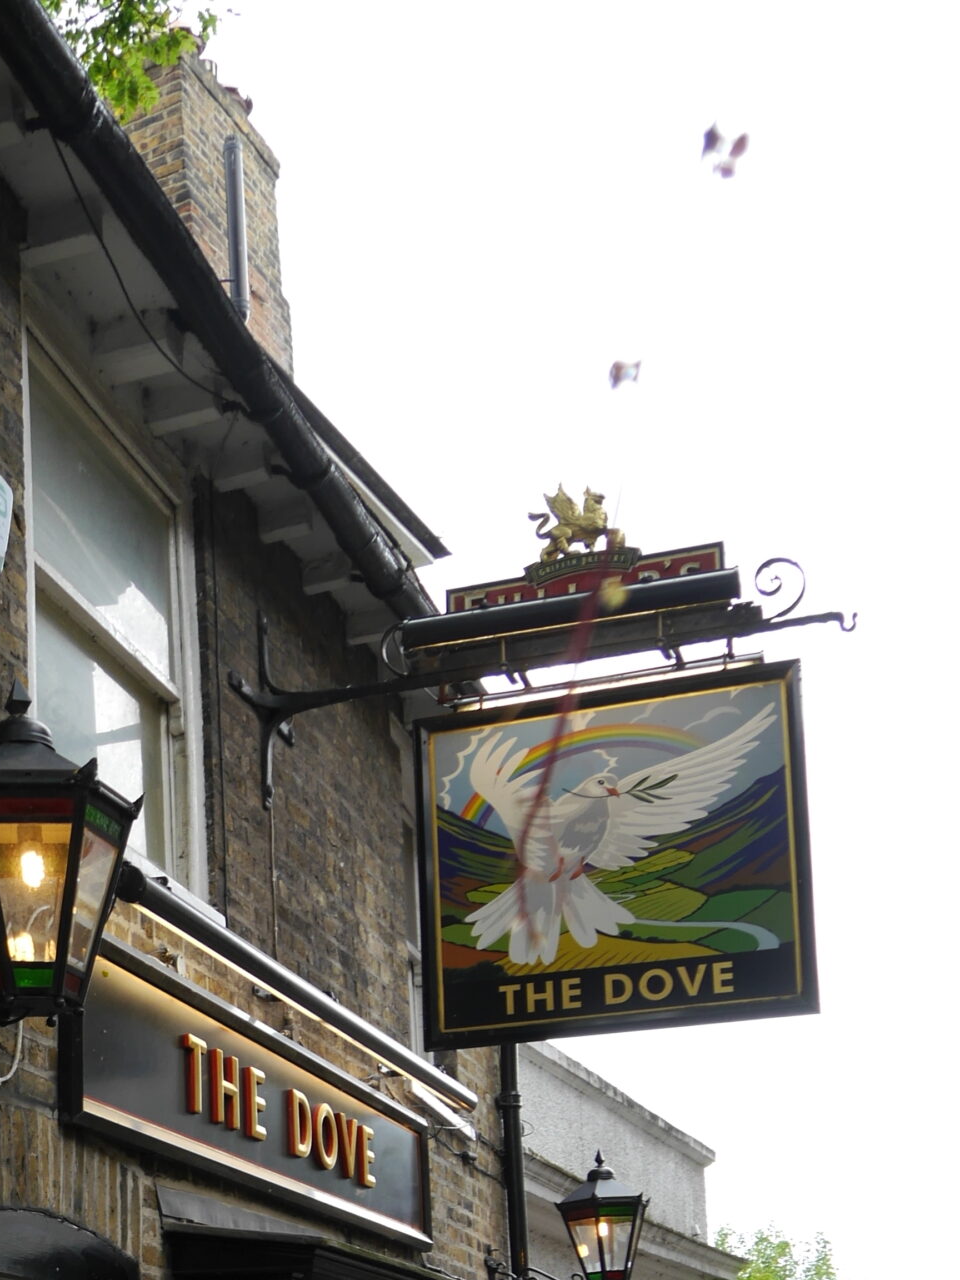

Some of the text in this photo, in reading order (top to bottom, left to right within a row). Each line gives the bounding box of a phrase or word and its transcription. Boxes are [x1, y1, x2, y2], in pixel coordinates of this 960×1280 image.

[581, 554, 625, 566] BRERY
[499, 960, 736, 1016] THE DOVE
[182, 1033, 377, 1188] THE DOVE
